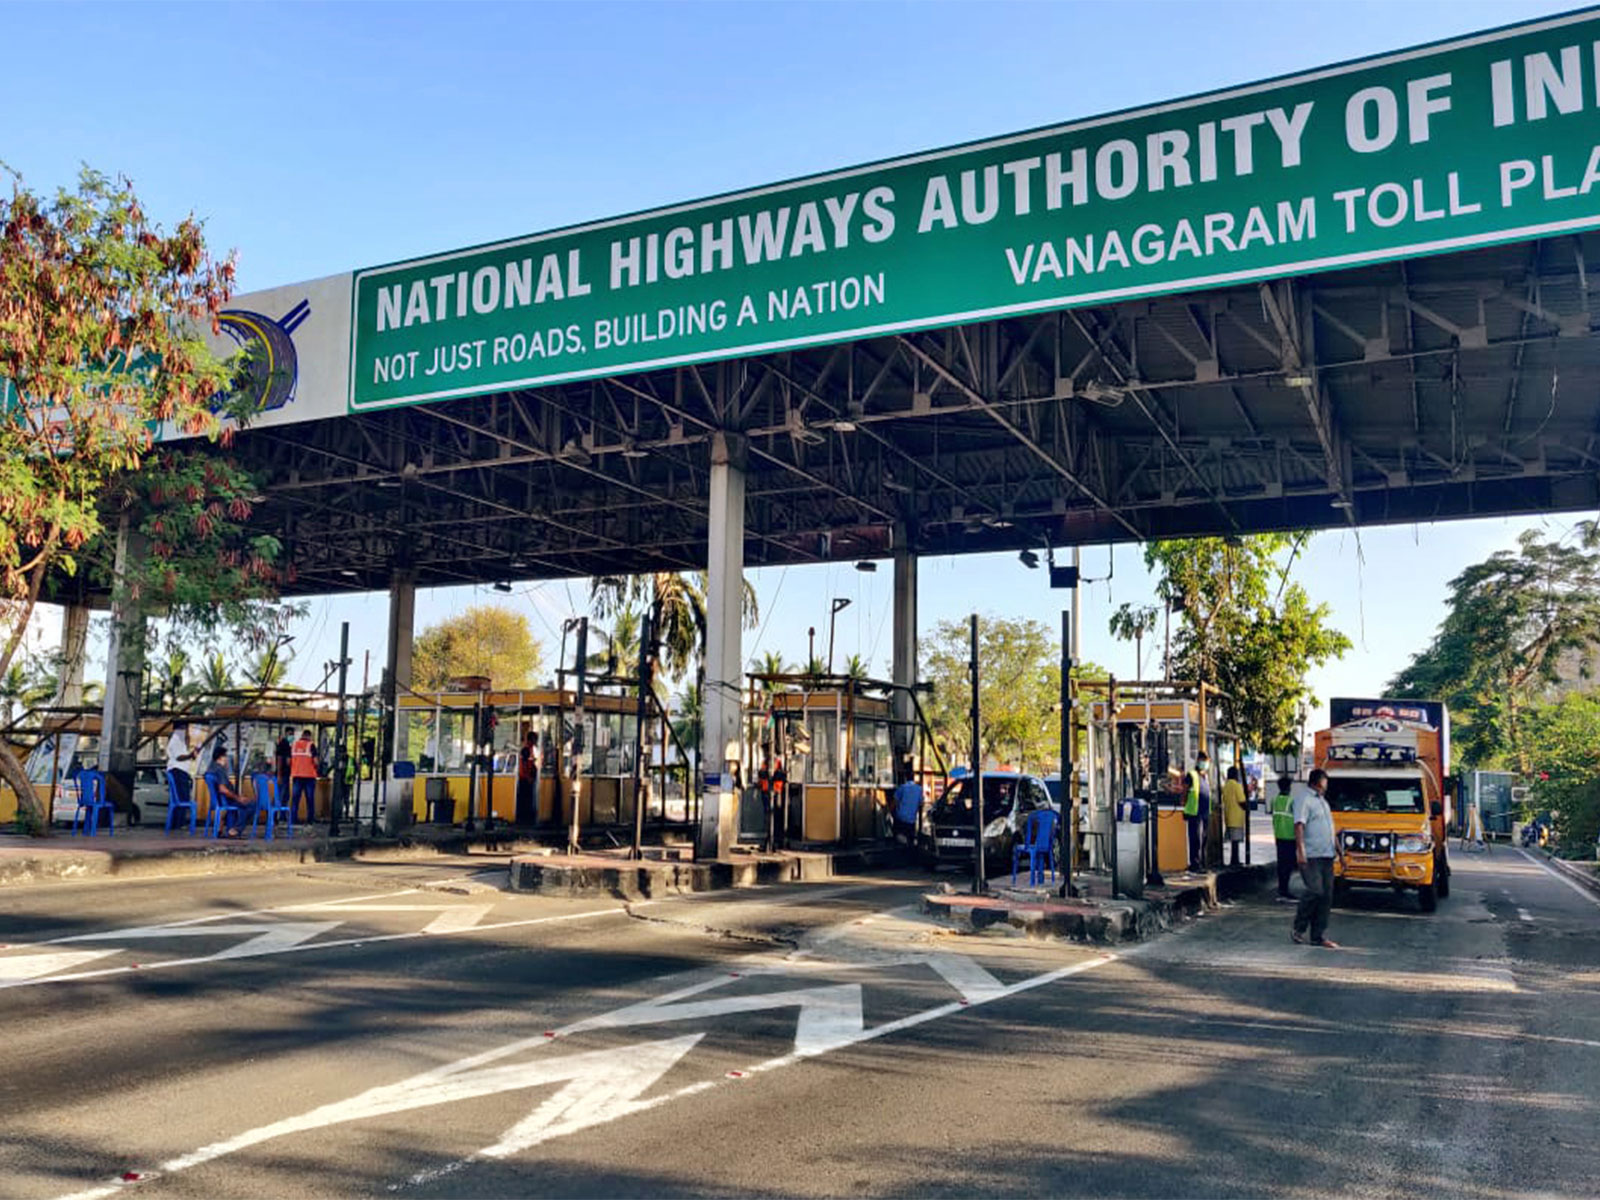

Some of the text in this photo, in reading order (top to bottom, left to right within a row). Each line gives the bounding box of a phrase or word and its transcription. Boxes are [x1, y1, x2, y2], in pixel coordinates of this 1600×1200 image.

[376, 40, 1600, 332] NATIONAL HIGHWAYS AUTHORITY OF IN
[1005, 197, 1317, 286] VANAGARAM
[1333, 172, 1482, 233] TOLL
[373, 272, 886, 384] NOT JUST ROADS, BUILDING A NATION
